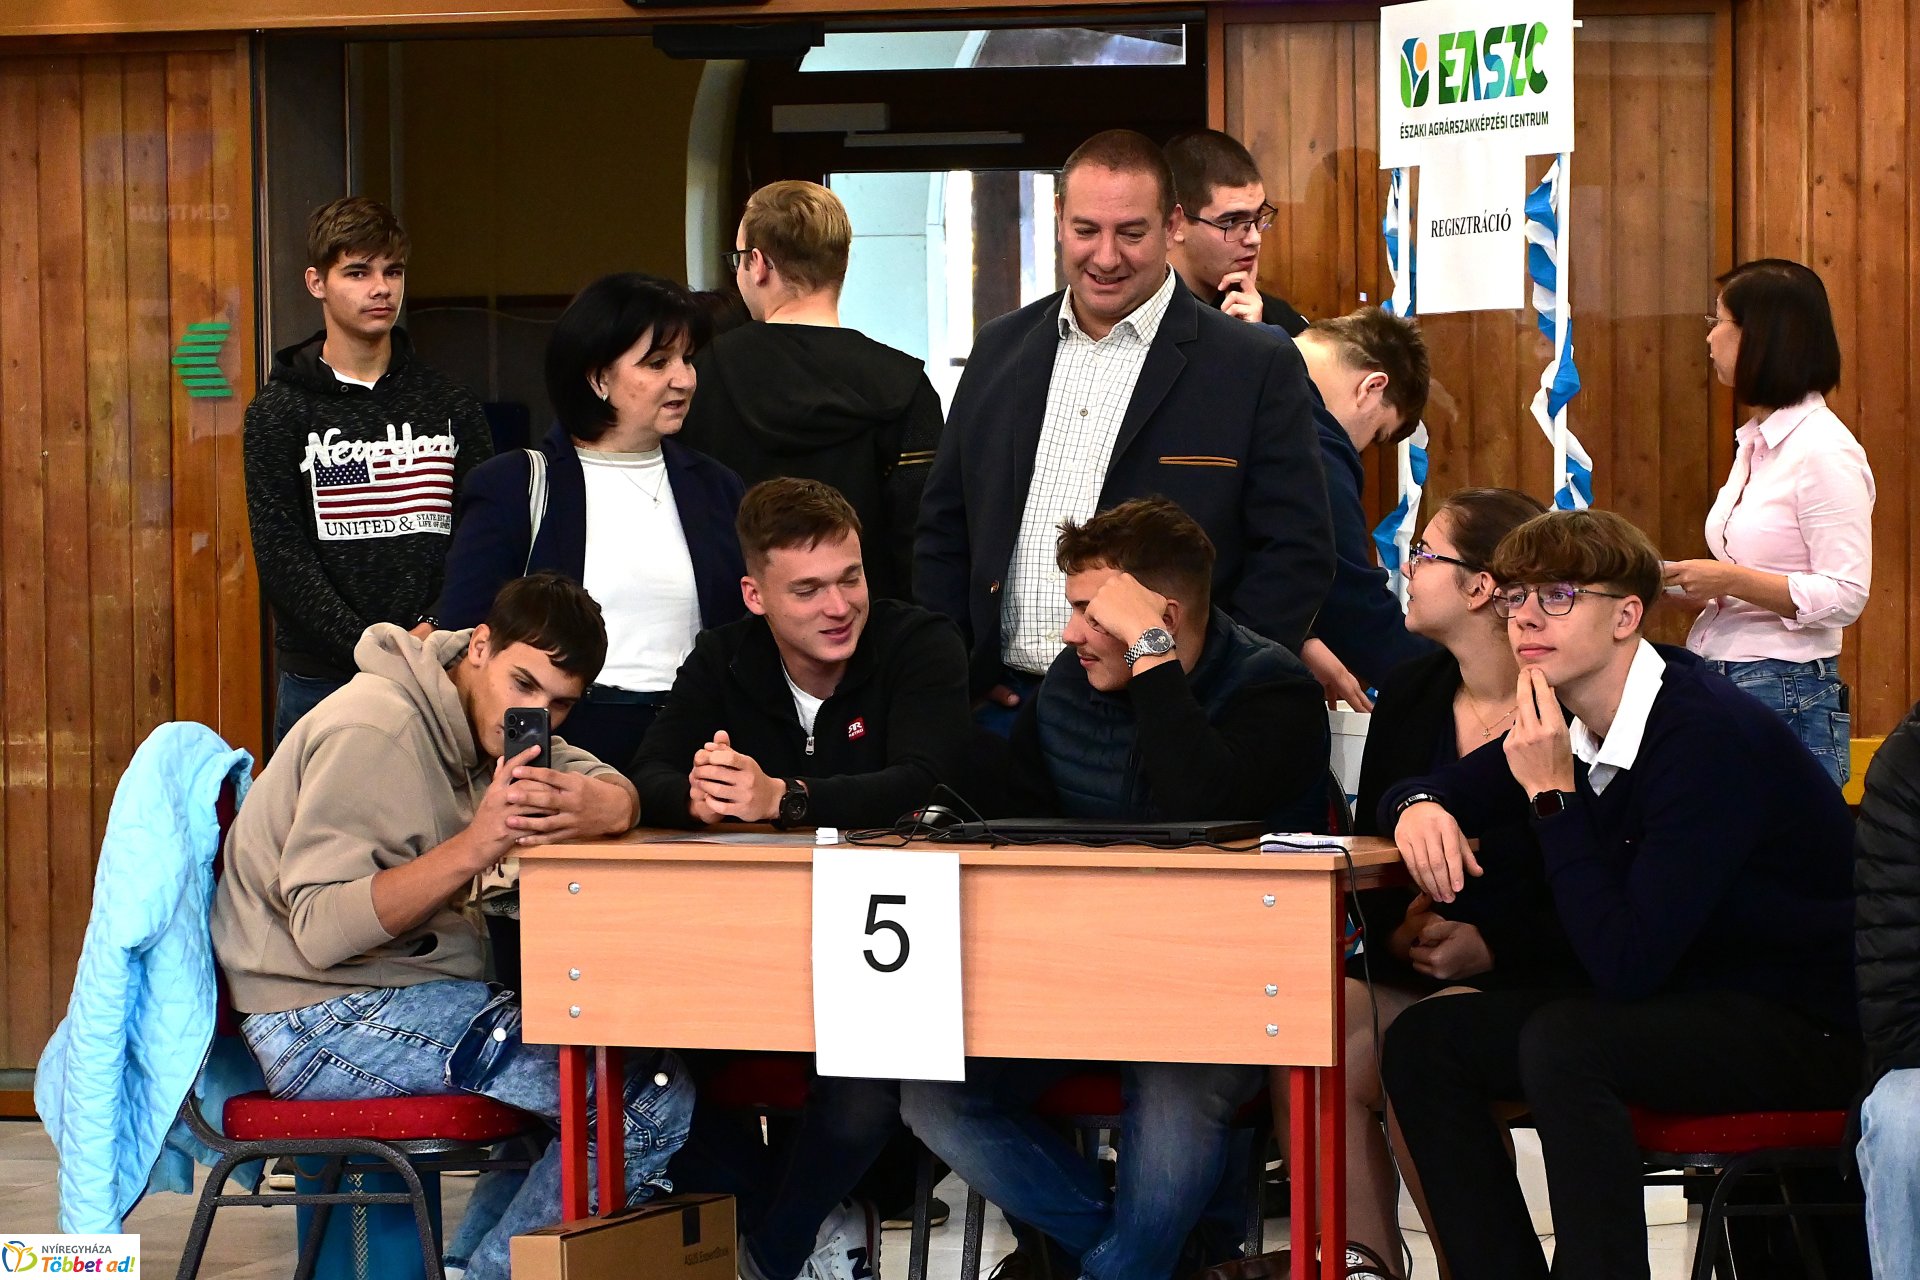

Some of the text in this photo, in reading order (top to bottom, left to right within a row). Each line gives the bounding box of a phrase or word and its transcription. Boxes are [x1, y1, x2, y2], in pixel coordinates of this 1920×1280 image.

[1438, 21, 1549, 105] EASZC
[1400, 111, 1549, 139] ÉSZAKI AGRÁRSZAKKÉPZÉSI CENTRUM
[1430, 207, 1512, 238] REGISZTRÁCIÓ
[325, 516, 415, 536] UNITED &
[418, 520, 432, 528] LIFE
[863, 894, 910, 973] 5
